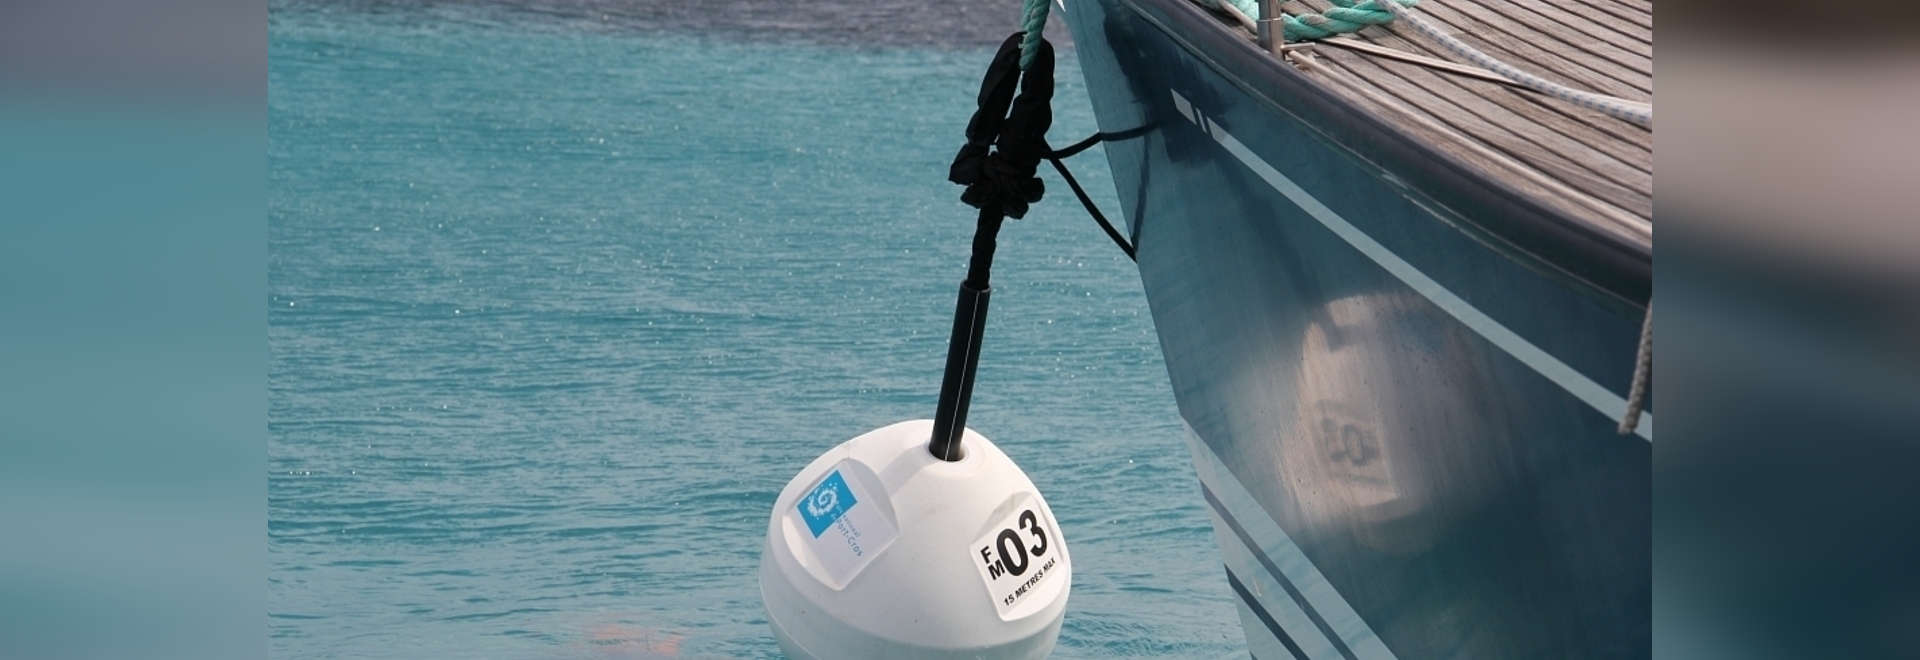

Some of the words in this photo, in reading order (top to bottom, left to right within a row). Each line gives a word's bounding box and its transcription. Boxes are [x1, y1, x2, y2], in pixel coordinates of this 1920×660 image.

[836, 518, 863, 556] Port-Cros
[980, 546, 992, 565] F
[996, 509, 1047, 576] 03
[987, 559, 1006, 581] M
[1004, 594, 1015, 606] 15
[1015, 569, 1043, 598] METRES
[1043, 557, 1055, 572] MAX
